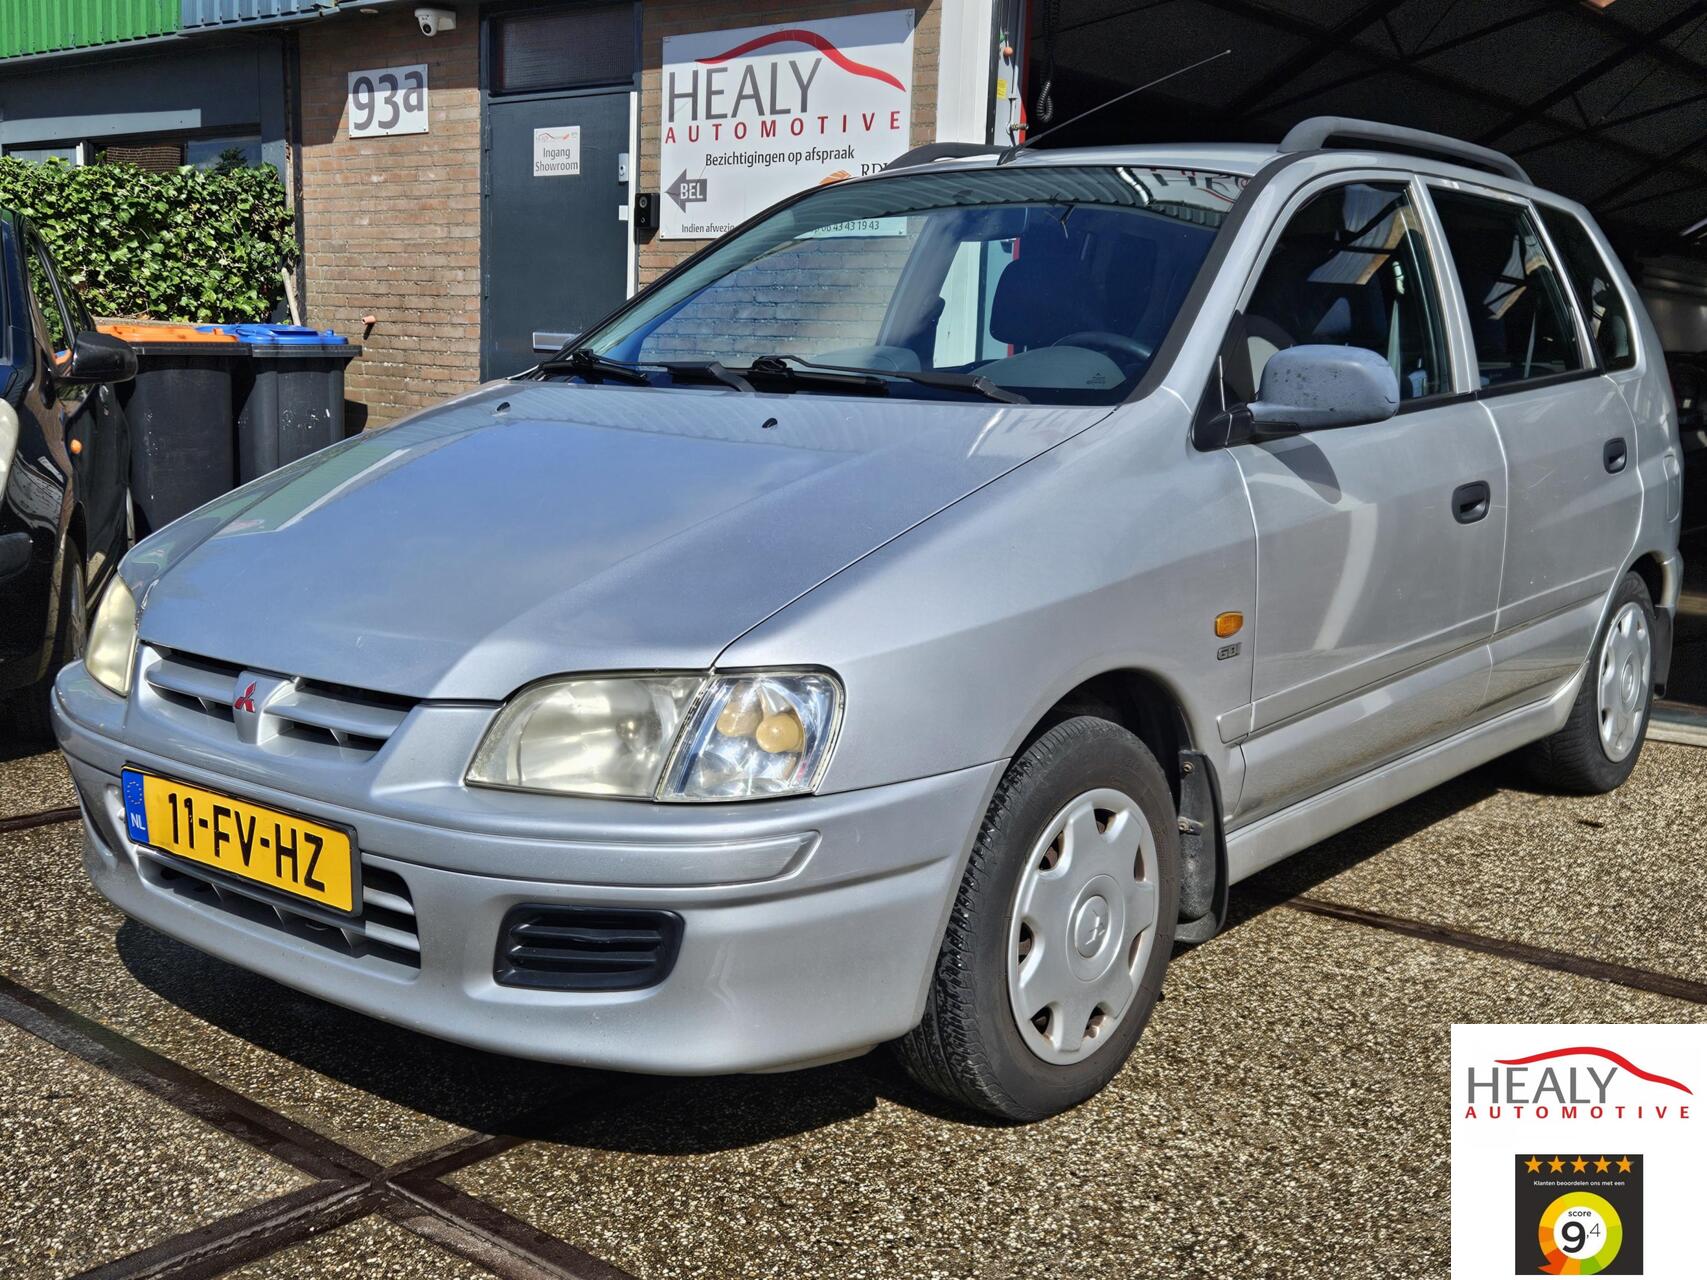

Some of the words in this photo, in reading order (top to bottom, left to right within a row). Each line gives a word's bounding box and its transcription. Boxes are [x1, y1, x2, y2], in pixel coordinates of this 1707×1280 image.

[668, 57, 822, 123] HEALY
[352, 70, 424, 131] 93a
[665, 111, 901, 144] AUTOMOTIVE
[543, 147, 570, 160] Ingang
[705, 150, 785, 167] Bezichtigingen
[788, 152, 802, 165] op
[804, 145, 855, 163] afspraak
[535, 160, 578, 172] Showroom
[680, 183, 703, 199] BEL
[681, 223, 704, 233] Indien
[845, 222, 856, 231] 43
[858, 221, 867, 230] 19
[869, 220, 880, 230] 43
[130, 812, 146, 831] NL
[168, 793, 325, 892] 11-FV-HZ
